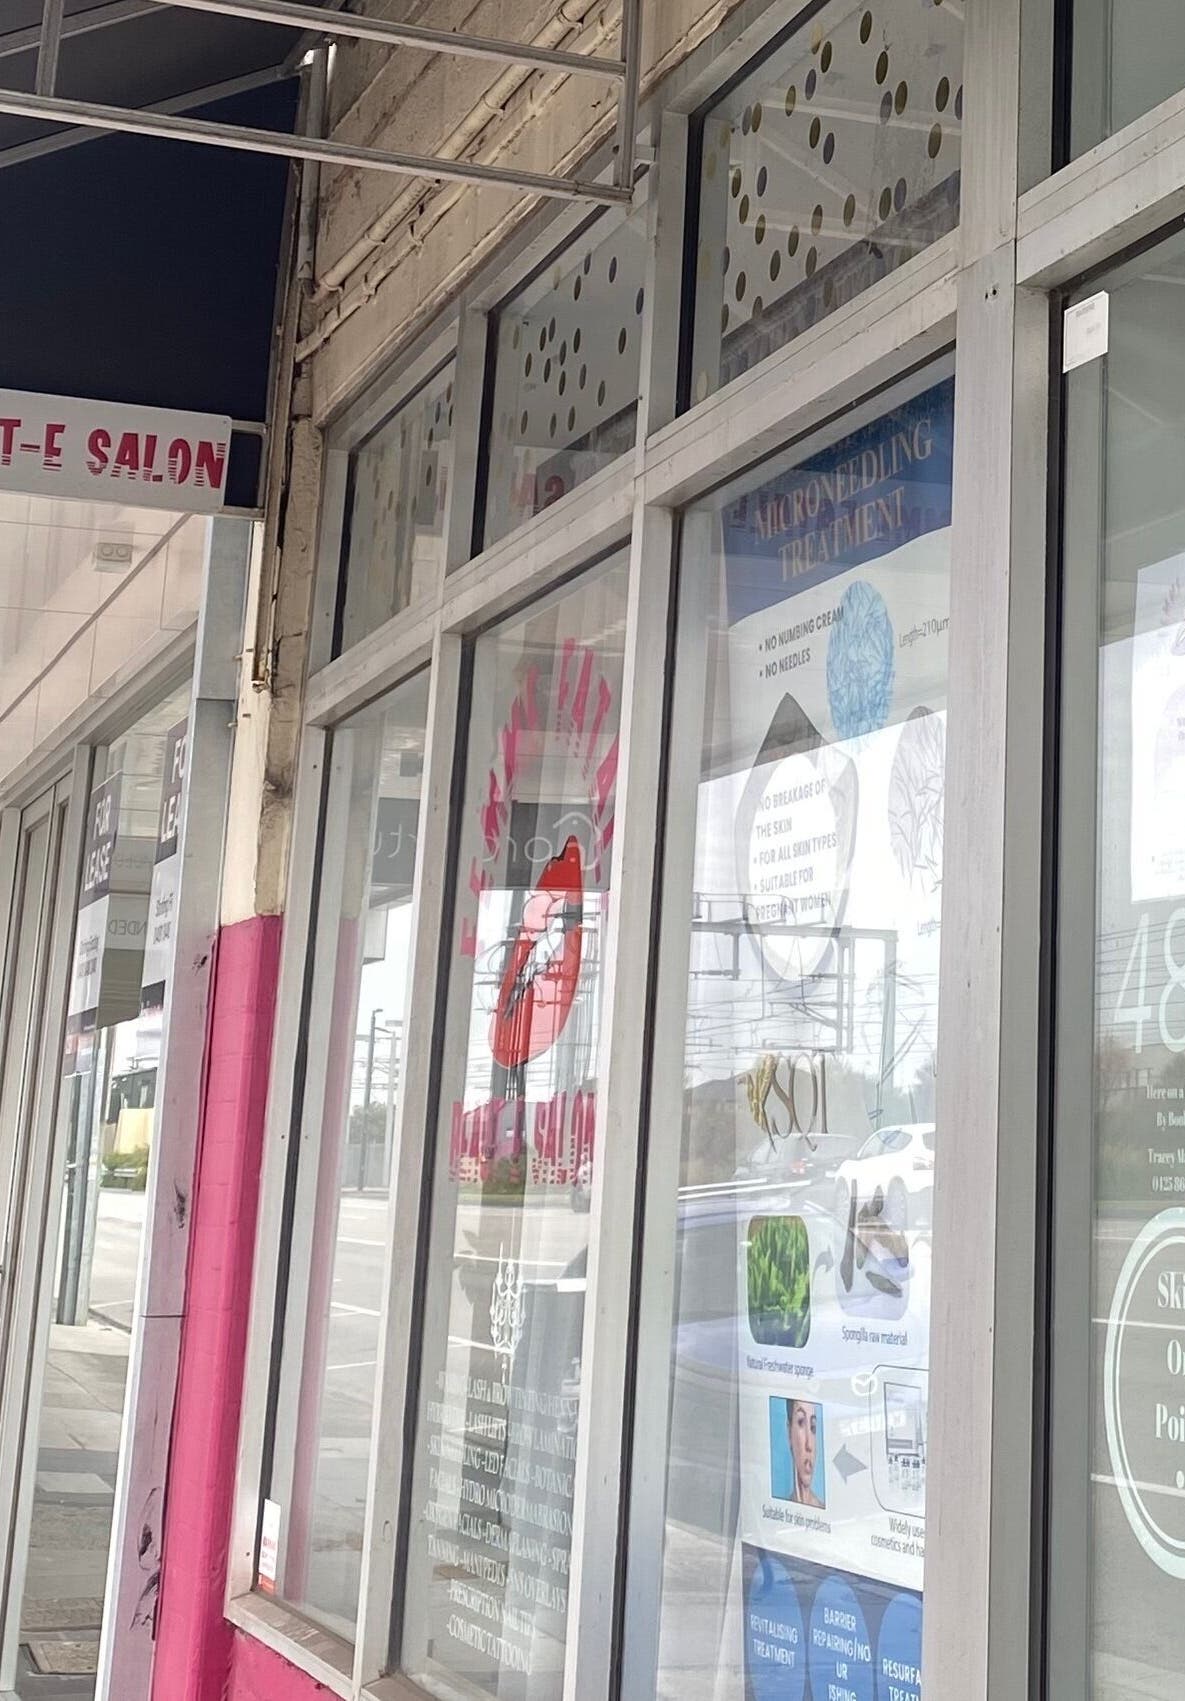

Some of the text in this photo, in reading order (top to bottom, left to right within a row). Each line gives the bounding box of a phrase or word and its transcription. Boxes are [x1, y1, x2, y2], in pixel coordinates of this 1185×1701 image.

[86, 428, 226, 489] SALON
[755, 419, 933, 544] MICRONEEDLING
[779, 486, 905, 582] TREATMENT
[764, 606, 845, 651] NO NUMBING CREAM
[764, 648, 812, 679] NO NEEDLES
[773, 782, 814, 809] BREAKAGE
[815, 778, 826, 797] OF
[756, 817, 792, 840] THE SKIN
[759, 832, 838, 866] FOR ALL SKIN TYPES
[760, 867, 814, 893] SUITABLE FOR
[1156, 1111, 1166, 1132] By
[1147, 1148, 1175, 1168] Tracey
[842, 1325, 908, 1346] Spongilla raw material
[888, 1516, 911, 1539] Widely
[870, 1534, 901, 1552] cosmetics
[749, 1614, 798, 1645] REVITALISING
[823, 1607, 857, 1633] BARRIER
[753, 1639, 796, 1668] TREATMENT
[835, 1660, 849, 1681] UR
[882, 1657, 922, 1687] RESURFA
